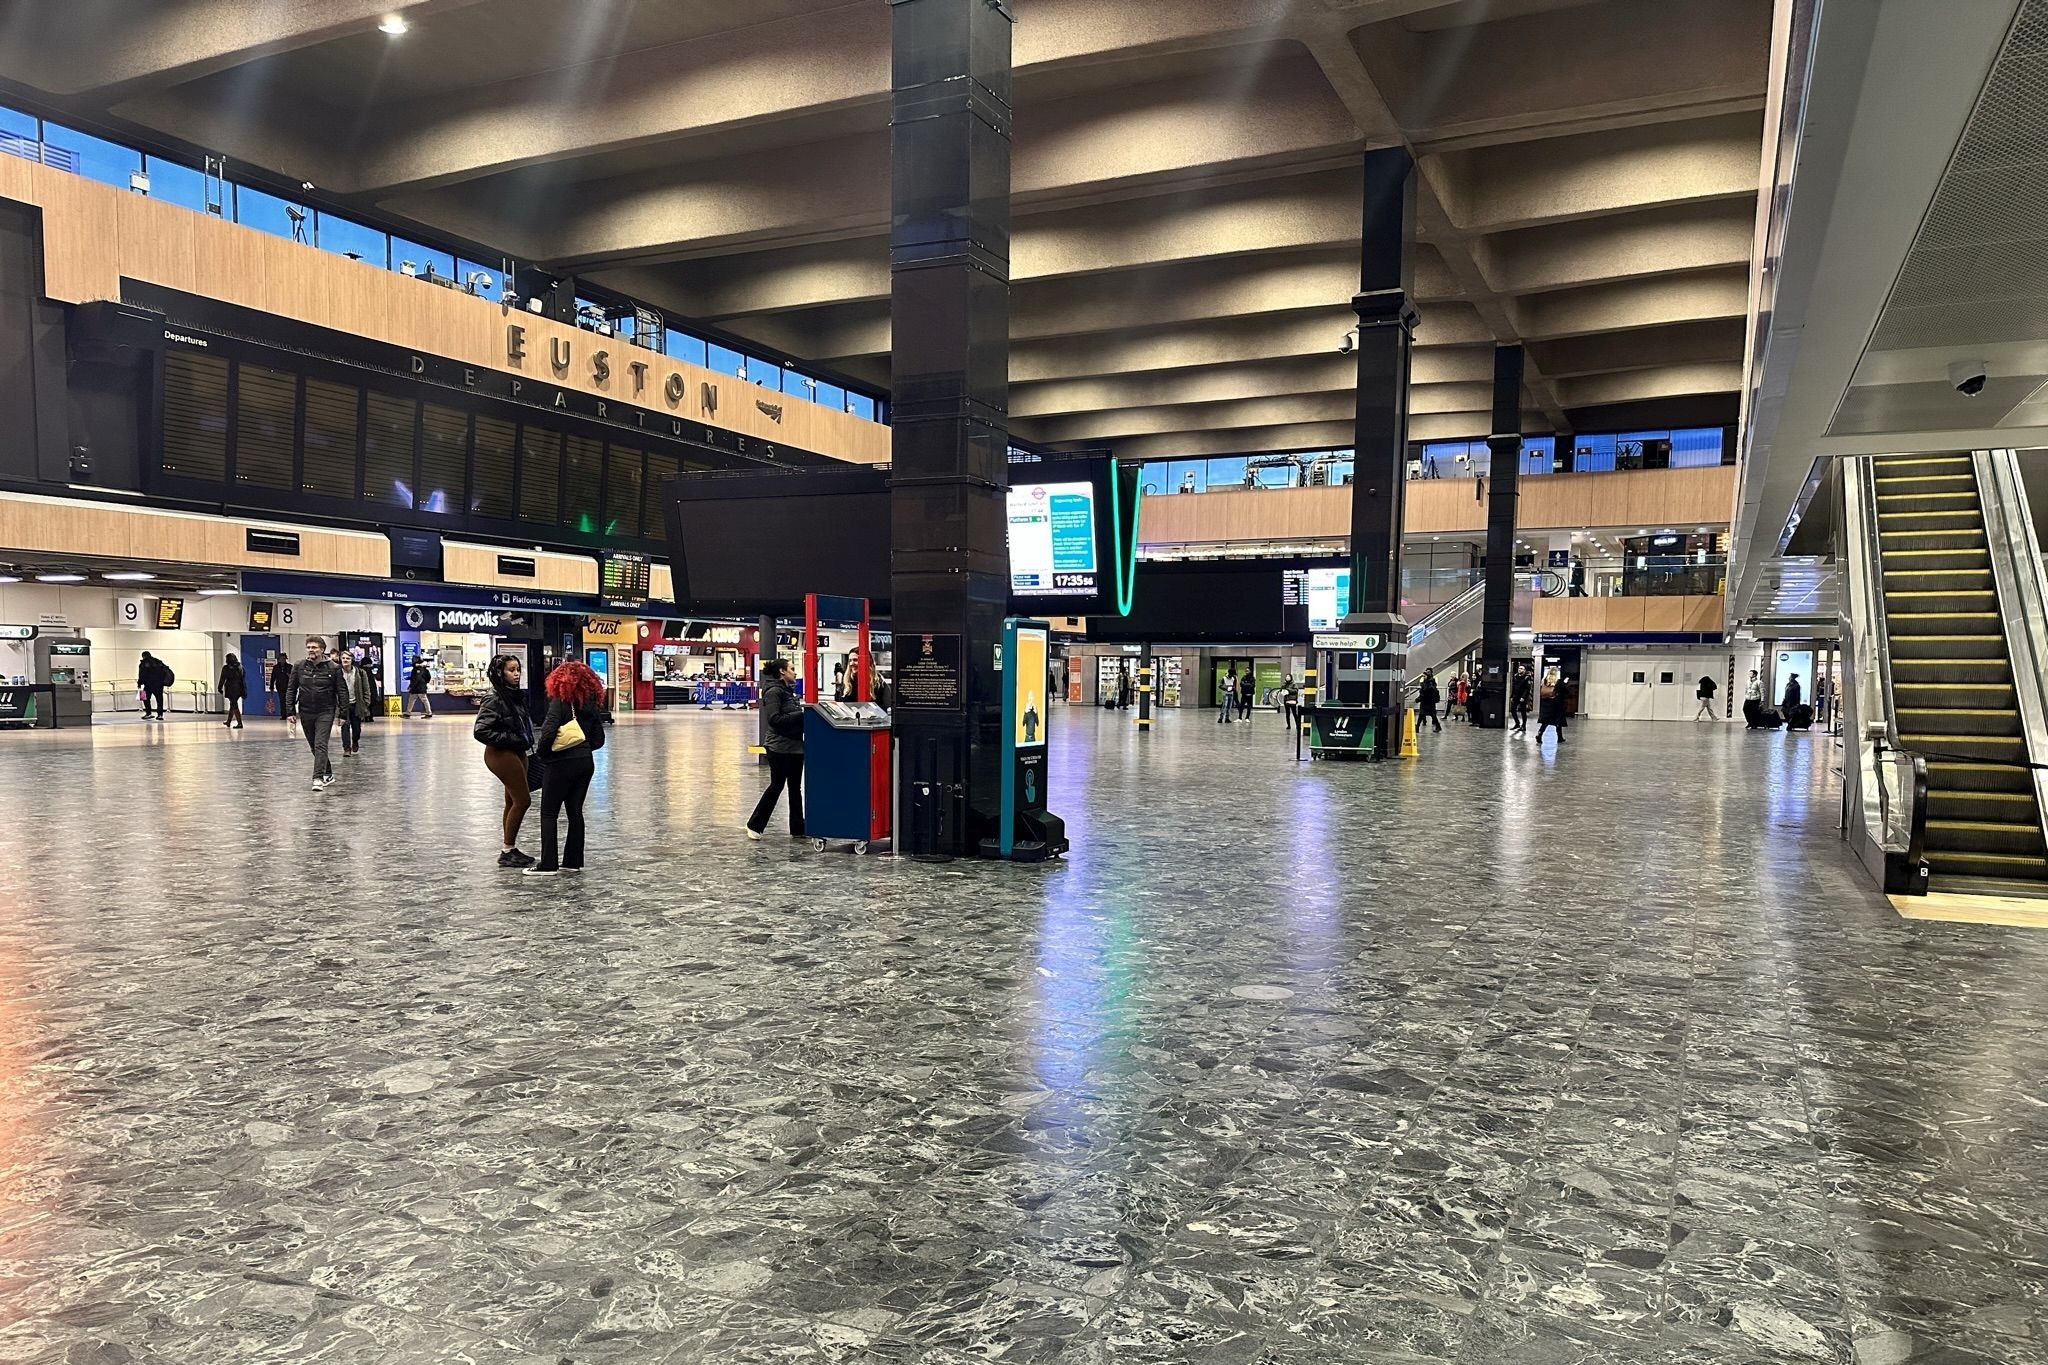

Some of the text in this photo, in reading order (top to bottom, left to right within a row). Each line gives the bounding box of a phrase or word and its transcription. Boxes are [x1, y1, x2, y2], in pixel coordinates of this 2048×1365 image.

[164, 330, 208, 347] Departures
[508, 325, 717, 410] EUSTON
[411, 356, 774, 458] DEPARTURES
[1055, 575, 1083, 587] 17:35
[512, 595, 541, 605] Platforms
[541, 597, 547, 605] 8
[554, 598, 562, 606] 11
[125, 603, 138, 620] 9
[283, 608, 293, 624] 8
[438, 610, 499, 630] panopolis
[587, 618, 622, 635] Crust
[711, 626, 740, 644] KING
[777, 635, 783, 644] 7
[786, 635, 791, 644] 7
